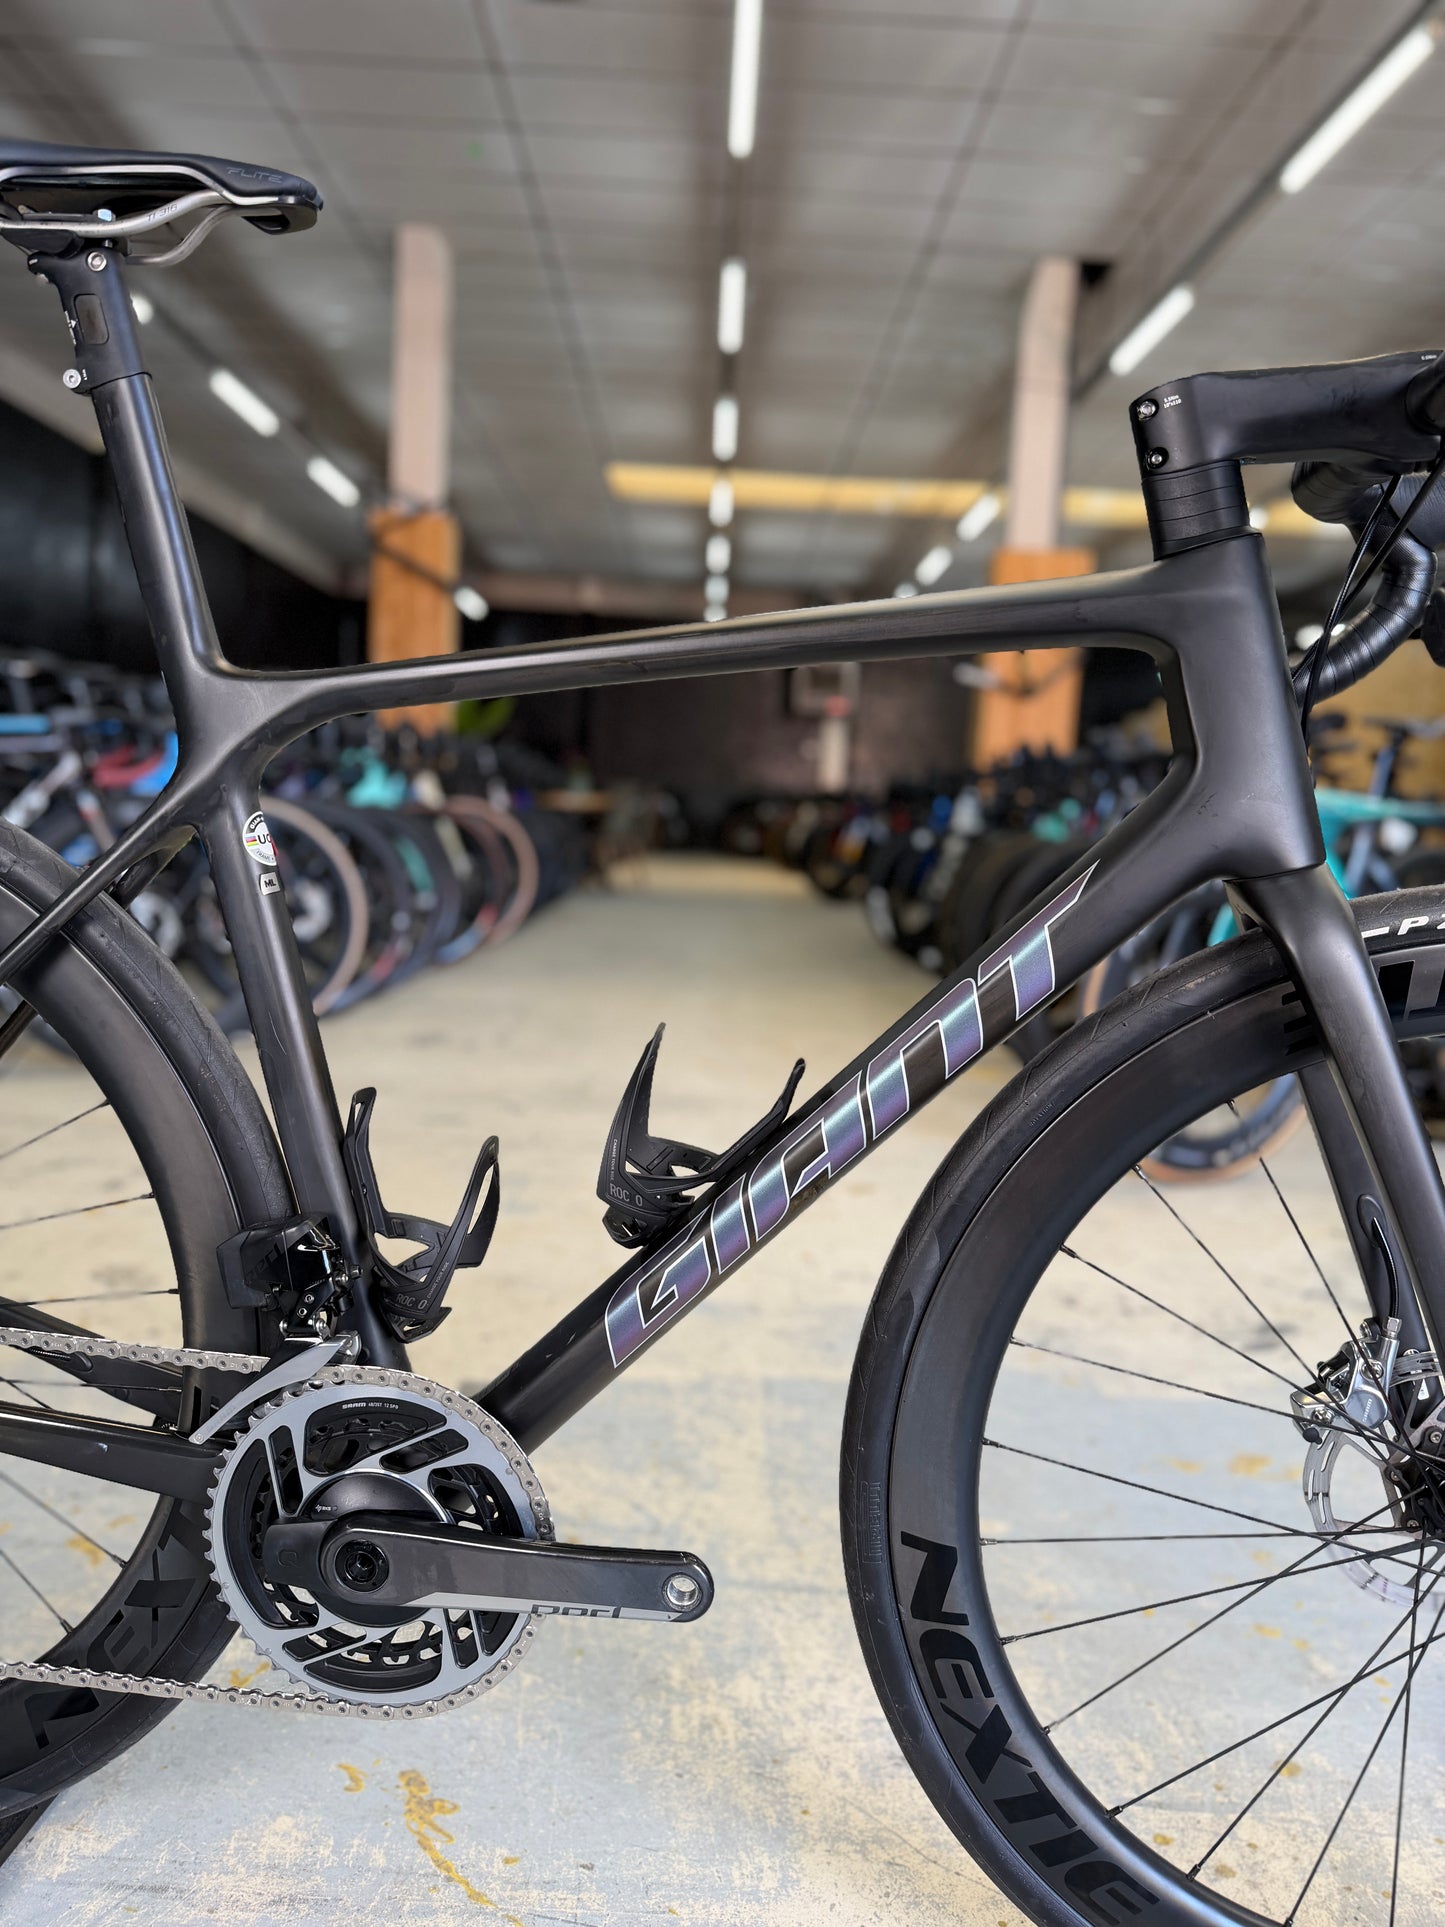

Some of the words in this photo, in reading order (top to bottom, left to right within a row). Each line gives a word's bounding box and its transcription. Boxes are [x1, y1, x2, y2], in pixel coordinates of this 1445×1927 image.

[226, 167, 282, 184] FLITE
[264, 879, 277, 888] ML
[604, 859, 1100, 1368] GIANT
[901, 1531, 1160, 1926] NEXTIE
